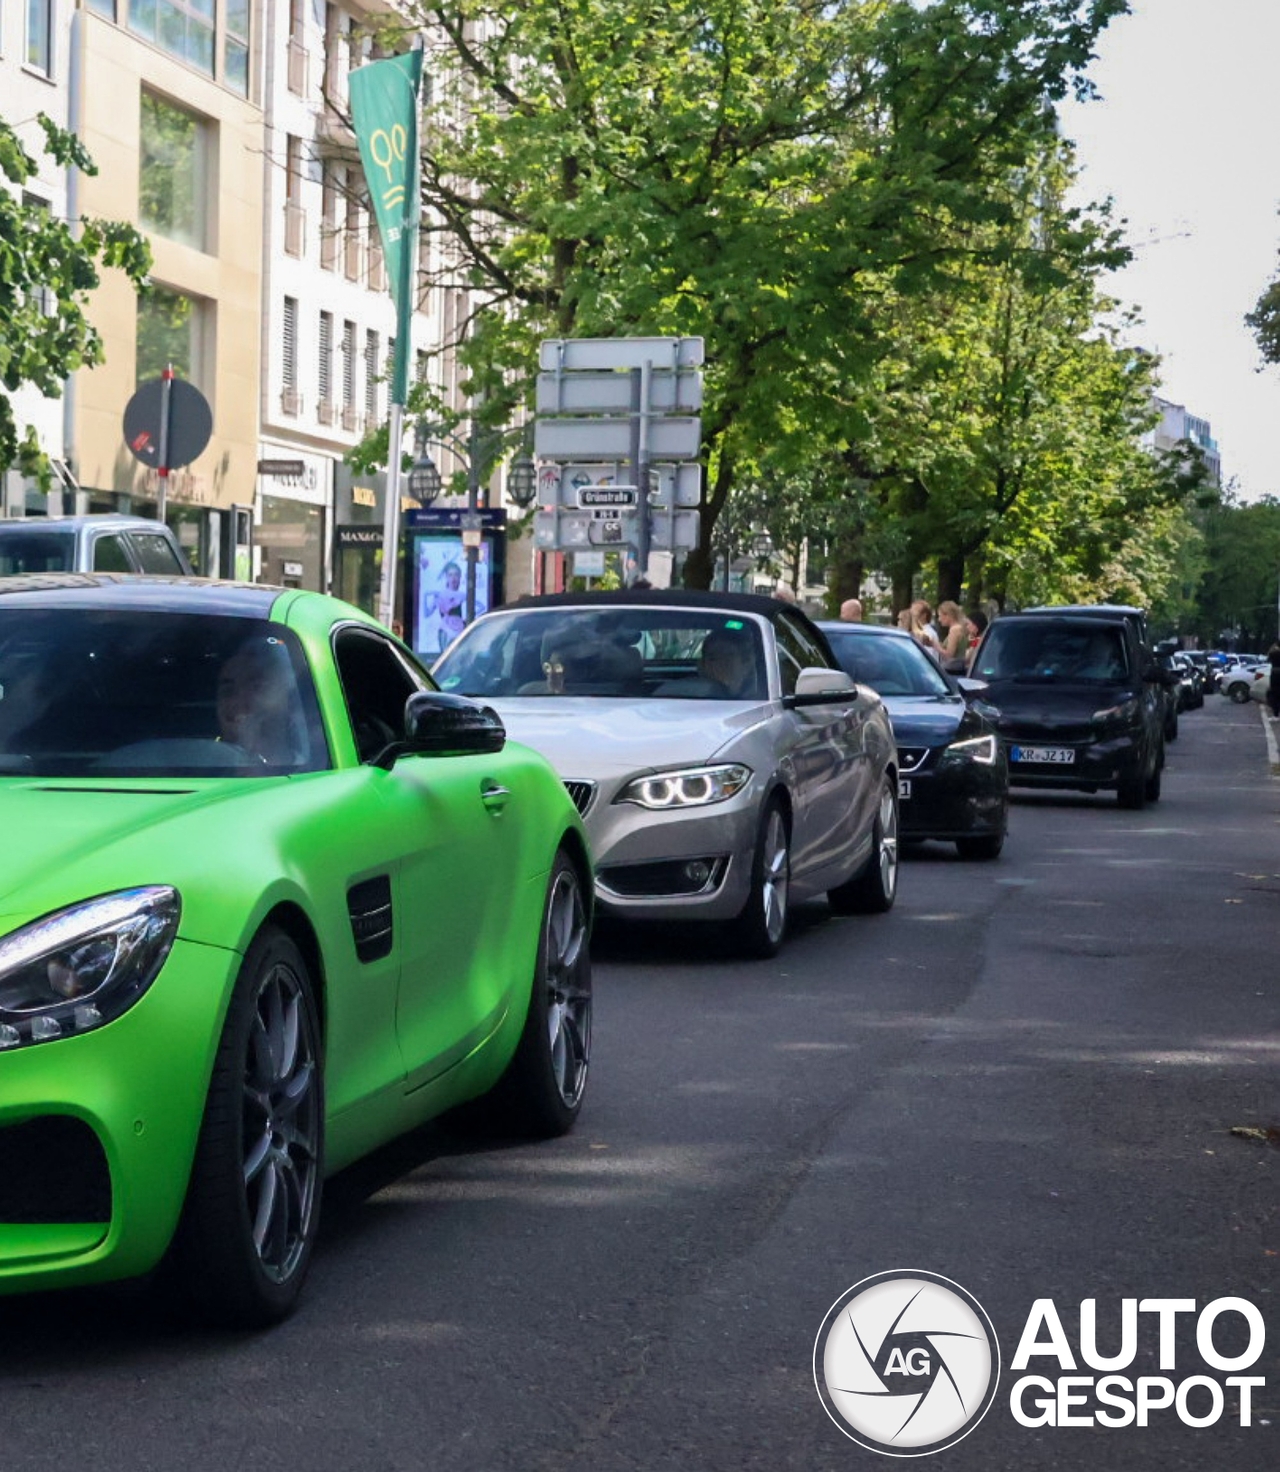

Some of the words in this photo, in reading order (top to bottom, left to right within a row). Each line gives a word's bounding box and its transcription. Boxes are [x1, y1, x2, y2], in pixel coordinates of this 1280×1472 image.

[585, 491, 628, 502] Grünstraße
[1019, 750, 1035, 760] KR
[1041, 751, 1058, 762] JZ
[1060, 751, 1073, 762] 17
[900, 782, 910, 796] 1
